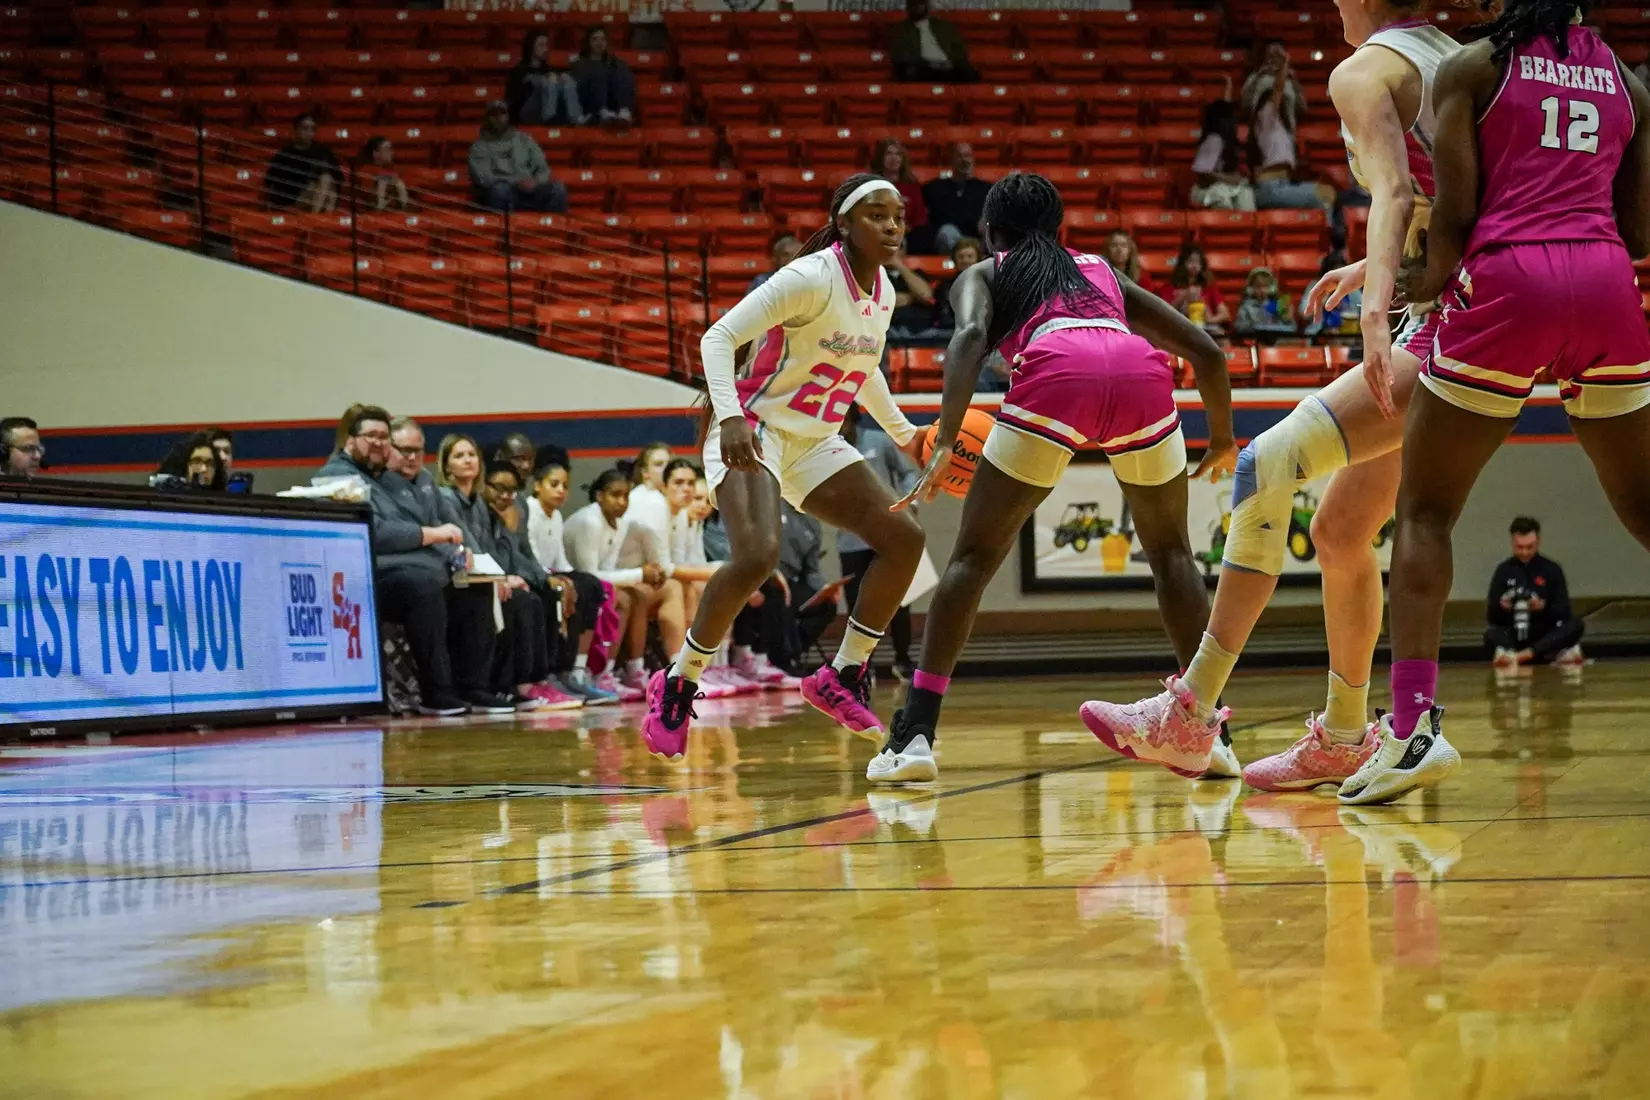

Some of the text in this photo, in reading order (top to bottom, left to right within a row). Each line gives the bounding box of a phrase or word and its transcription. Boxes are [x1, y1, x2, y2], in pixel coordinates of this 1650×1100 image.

[1519, 55, 1616, 95] BEARKATS
[1540, 95, 1601, 154] 12
[787, 362, 867, 423] 22
[289, 571, 317, 604] BUD
[89, 555, 139, 675] TO
[143, 558, 244, 673] ENJOY
[287, 605, 323, 637] LIGHT
